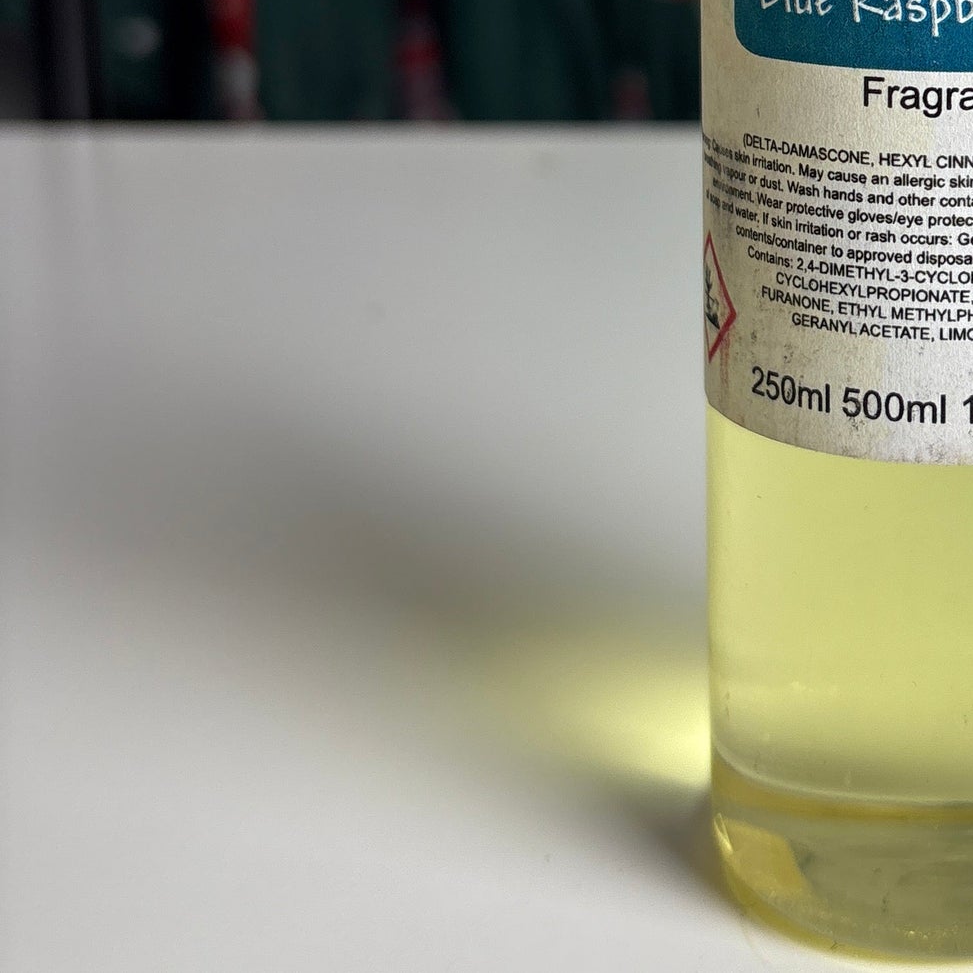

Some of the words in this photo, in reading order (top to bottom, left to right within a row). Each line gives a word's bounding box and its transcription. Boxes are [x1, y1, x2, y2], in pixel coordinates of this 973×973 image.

[743, 133, 874, 167] (DELTA-DAMASCONE,
[879, 153, 931, 168] HEXYL
[735, 150, 750, 165] skin
[753, 155, 795, 175] irritation.
[799, 163, 823, 181] May
[828, 170, 866, 183] cause
[872, 174, 889, 184] an
[894, 173, 944, 190] allergic
[749, 175, 757, 185] or
[760, 177, 783, 192] dust.
[787, 183, 820, 198] Wash
[824, 189, 862, 202] hands
[868, 192, 893, 205] and
[898, 195, 934, 206] other
[722, 201, 733, 213] and
[736, 207, 760, 223] water.
[762, 213, 769, 224] If
[771, 215, 792, 230] skin
[796, 220, 843, 238] irritation
[848, 229, 861, 240] or
[866, 230, 896, 243] rash
[901, 234, 952, 245] occurs:
[757, 191, 782, 208] Wear
[787, 201, 844, 219] protective
[848, 209, 923, 227] gloves/eye
[736, 224, 827, 255] contents/container
[831, 245, 843, 257] to
[847, 247, 912, 264] approved
[748, 246, 793, 268] Contains:
[762, 285, 834, 314] FURANONE,
[839, 302, 886, 319] ETHYL
[776, 272, 973, 304] CYCLOHEXYLPROPIONATE,
[792, 312, 857, 335] GERANYL
[860, 324, 934, 342] ACETATE,
[752, 366, 830, 413] 250ml
[842, 387, 946, 424] 500ml
